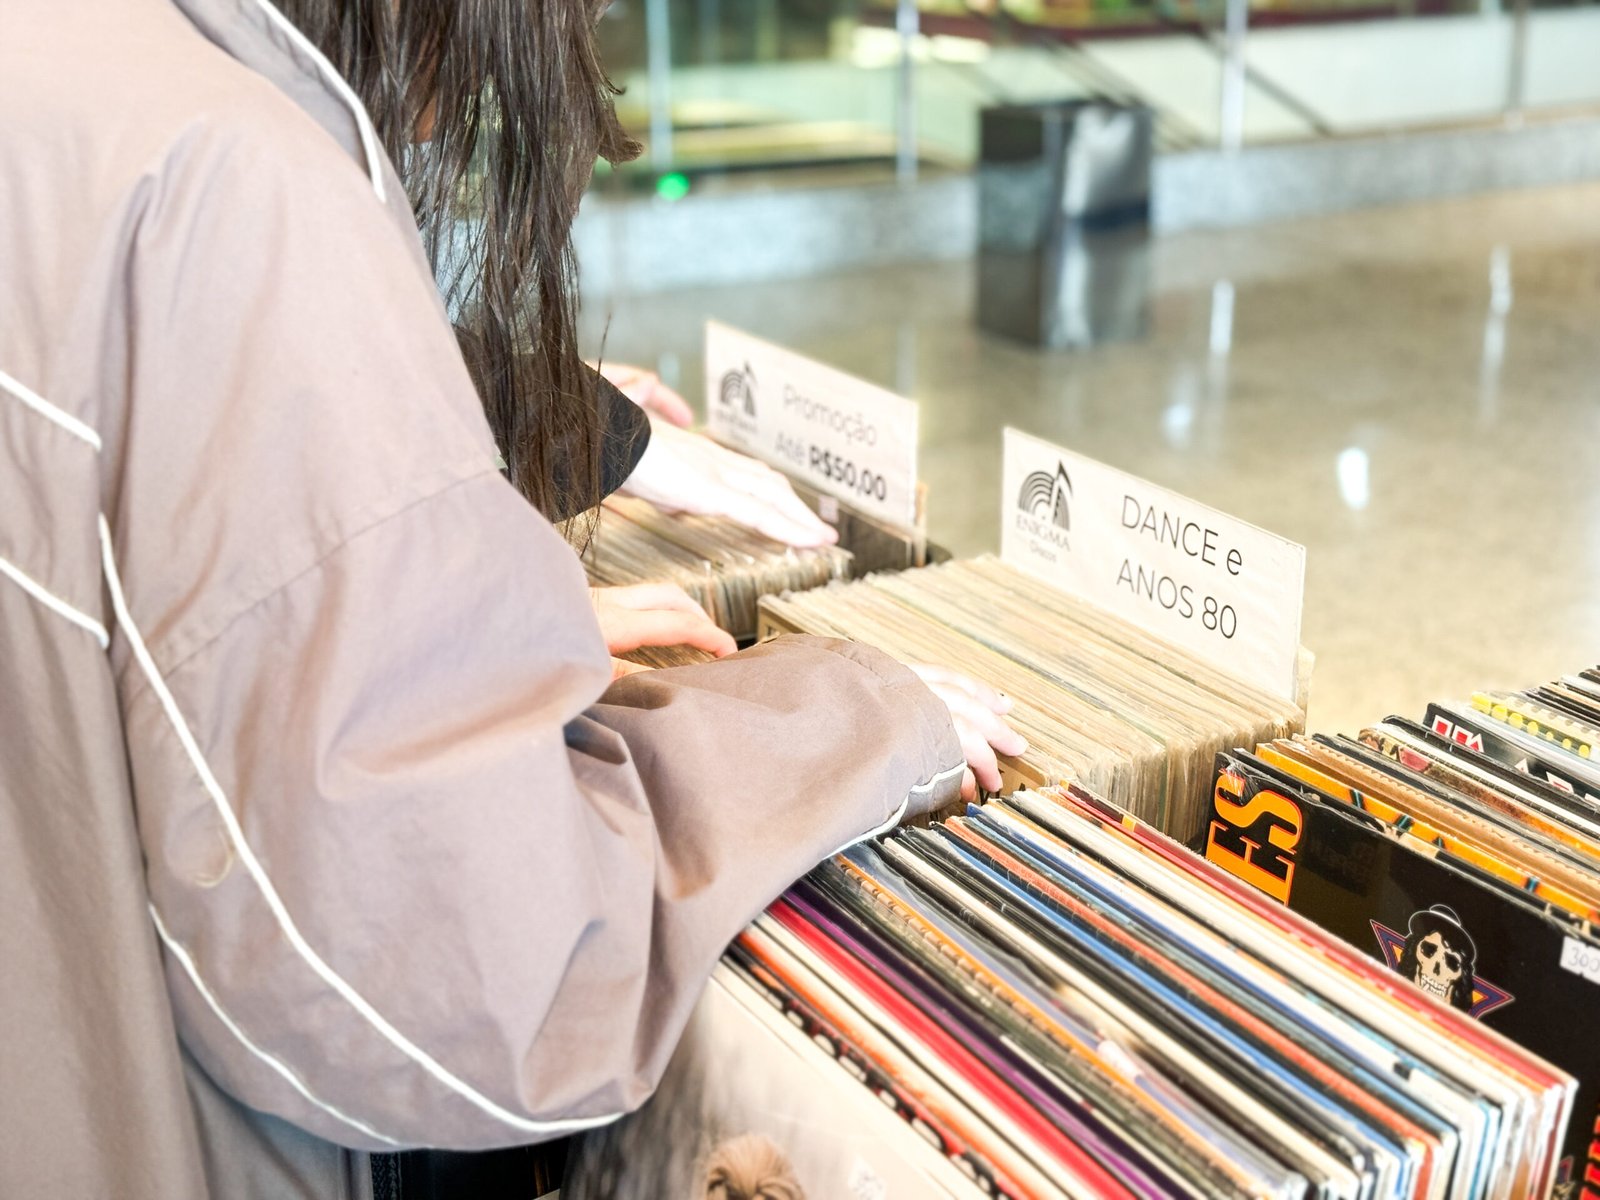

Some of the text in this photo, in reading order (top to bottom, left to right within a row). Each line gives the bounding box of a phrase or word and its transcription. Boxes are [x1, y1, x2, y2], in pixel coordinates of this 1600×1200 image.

[783, 384, 876, 447] Promoção
[809, 445, 886, 501] R$50,00
[1121, 495, 1242, 576] DANCE e
[1116, 558, 1237, 639] ANOS 80
